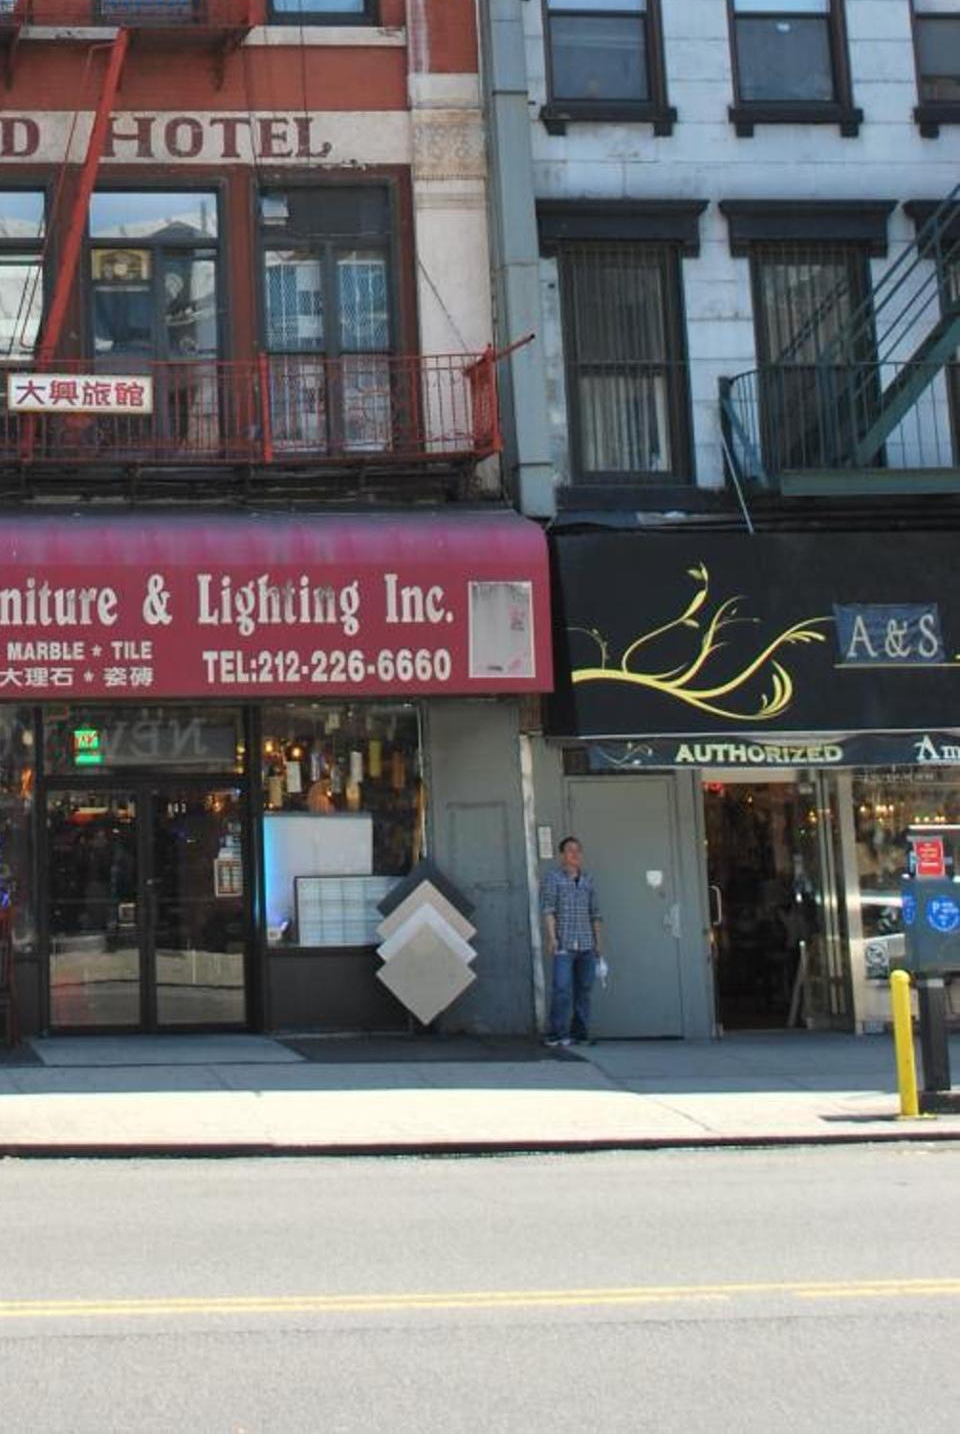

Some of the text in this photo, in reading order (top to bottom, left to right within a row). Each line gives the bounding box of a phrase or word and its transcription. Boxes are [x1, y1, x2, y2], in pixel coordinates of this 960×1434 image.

[96, 114, 334, 160] HOTEL
[15, 378, 145, 408] 大興旅館
[142, 573, 173, 625] &
[196, 573, 361, 637] Lighting
[384, 573, 454, 624] Inc.
[6, 641, 85, 661] MARBLE
[111, 641, 153, 660] TILE
[203, 649, 452, 684] TEL:212-226-6660
[674, 742, 844, 763] AUTHORIZED
